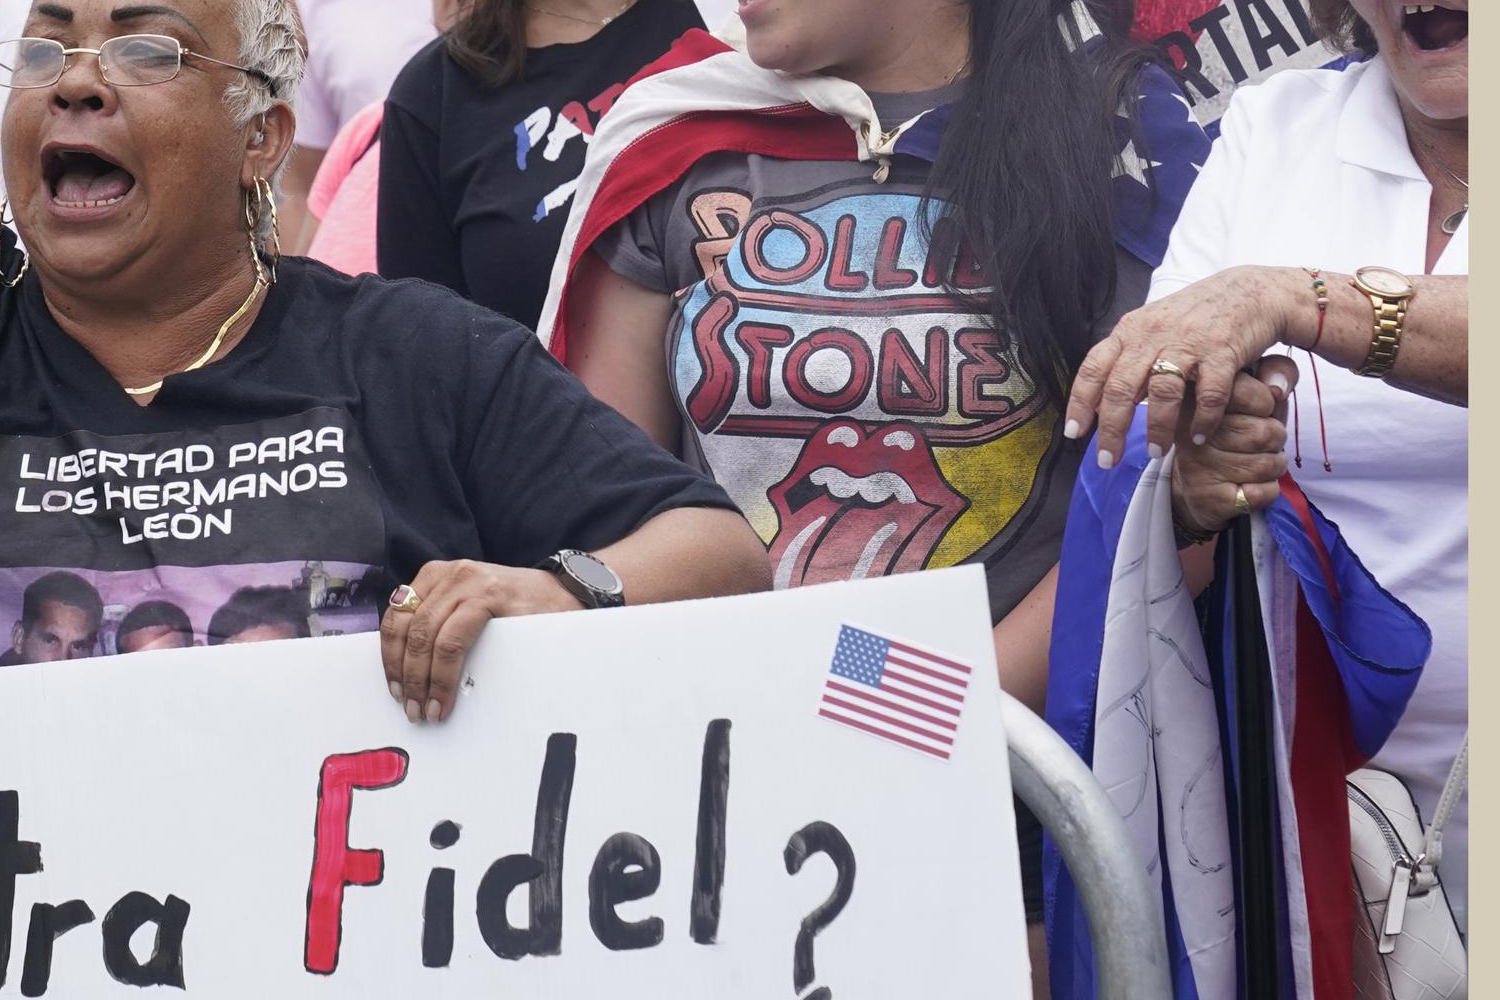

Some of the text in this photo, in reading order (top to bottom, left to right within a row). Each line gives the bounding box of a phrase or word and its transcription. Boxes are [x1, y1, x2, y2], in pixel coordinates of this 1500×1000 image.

[20, 426, 345, 482] LIBERTAD PARA
[15, 460, 348, 515] LOS HERMANOS
[120, 506, 232, 545] LEÓN
